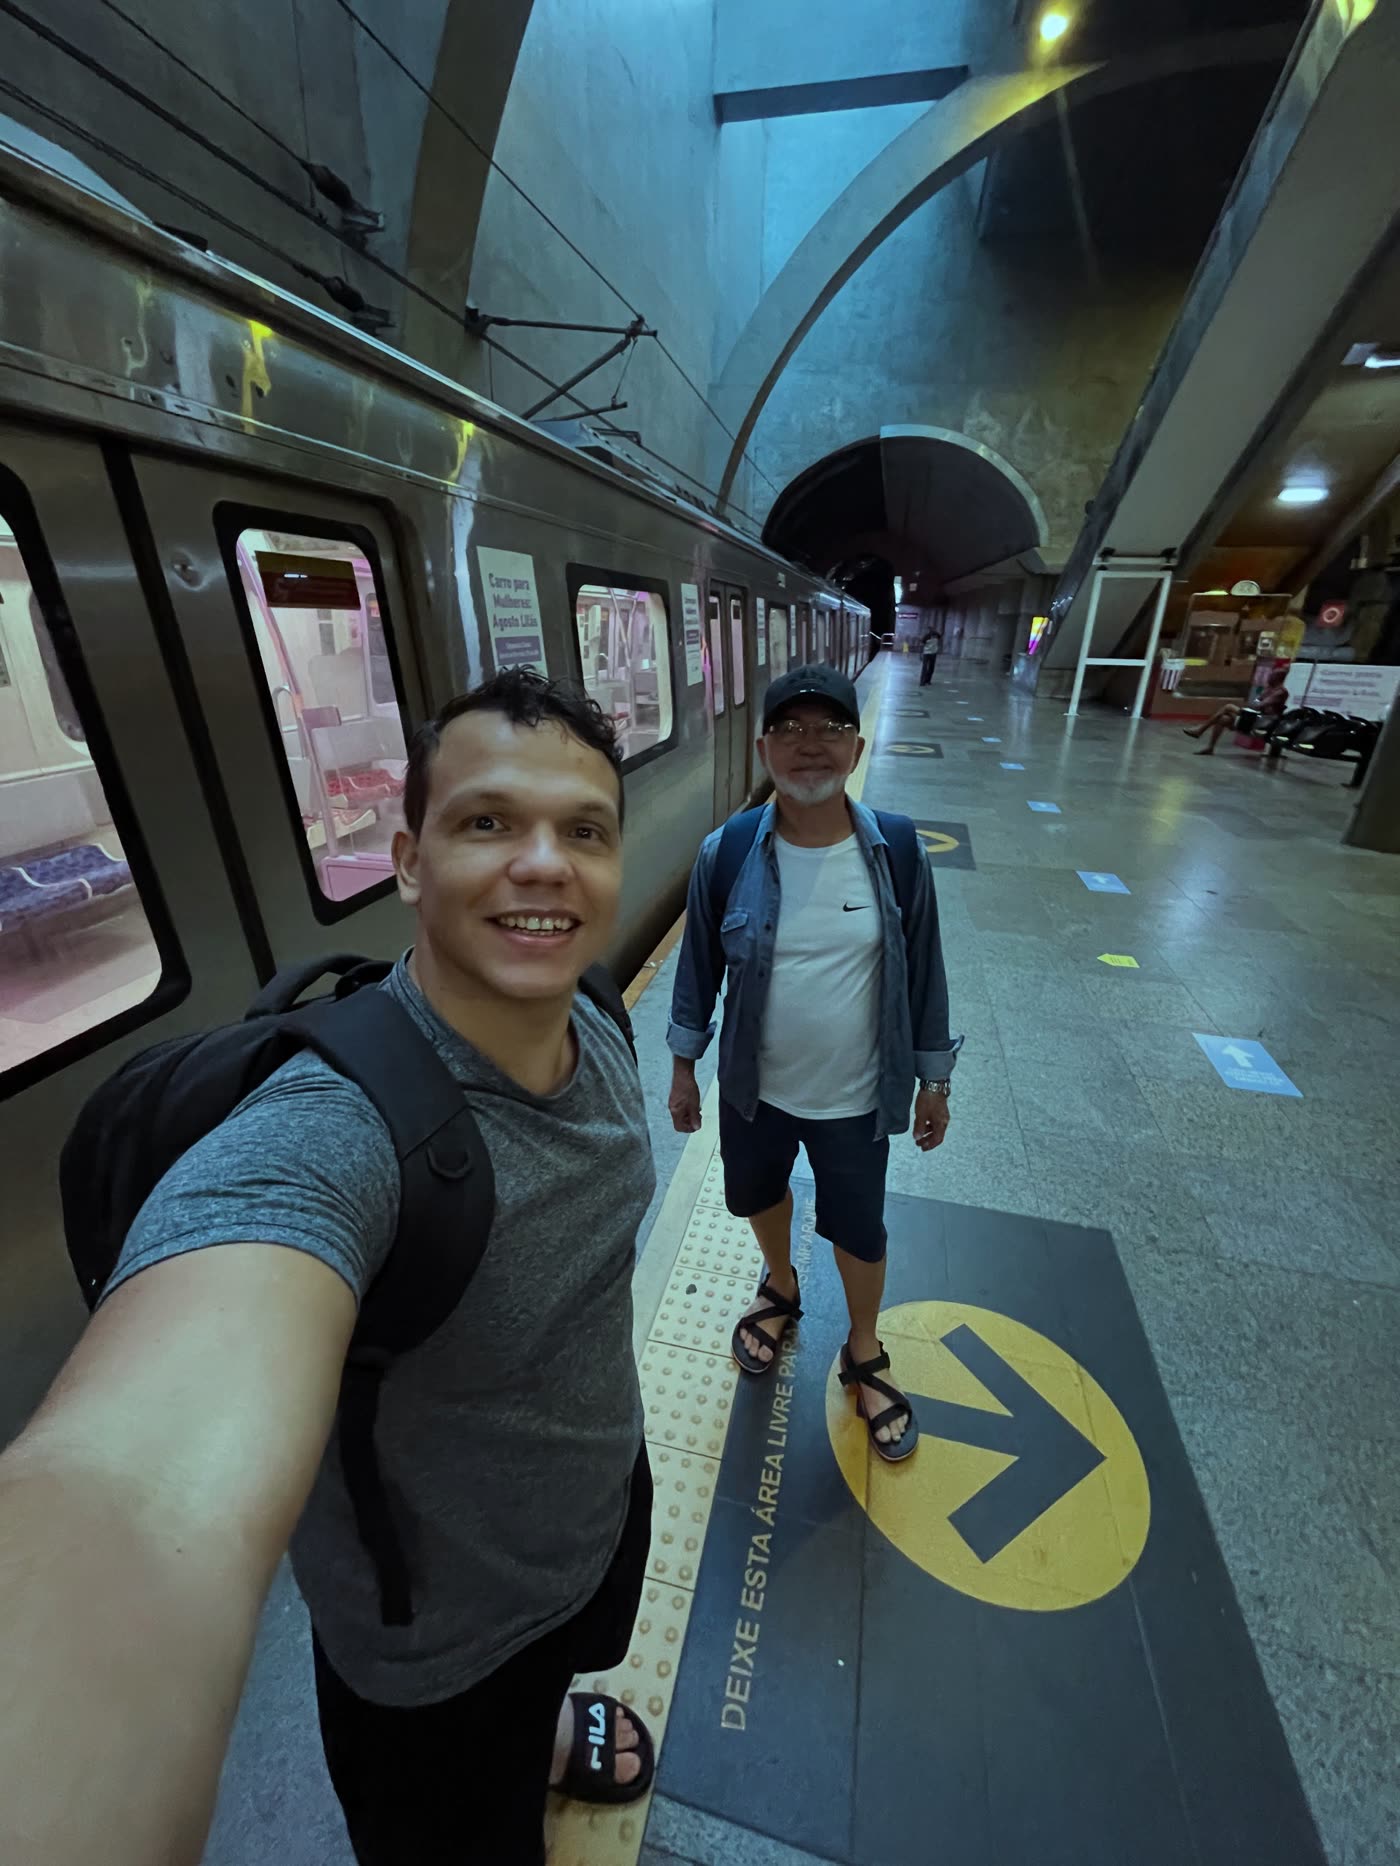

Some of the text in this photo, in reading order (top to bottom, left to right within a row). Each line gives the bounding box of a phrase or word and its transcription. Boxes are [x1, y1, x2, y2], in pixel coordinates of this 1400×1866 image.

[488, 573, 530, 592] Carro para
[777, 1327, 800, 1378] PARA
[767, 1382, 793, 1448] LIVRE
[751, 1453, 786, 1527] ÁREA
[741, 1533, 772, 1612] ESTA
[720, 1617, 760, 1731] DEIXE
[588, 1702, 606, 1770] FILA
